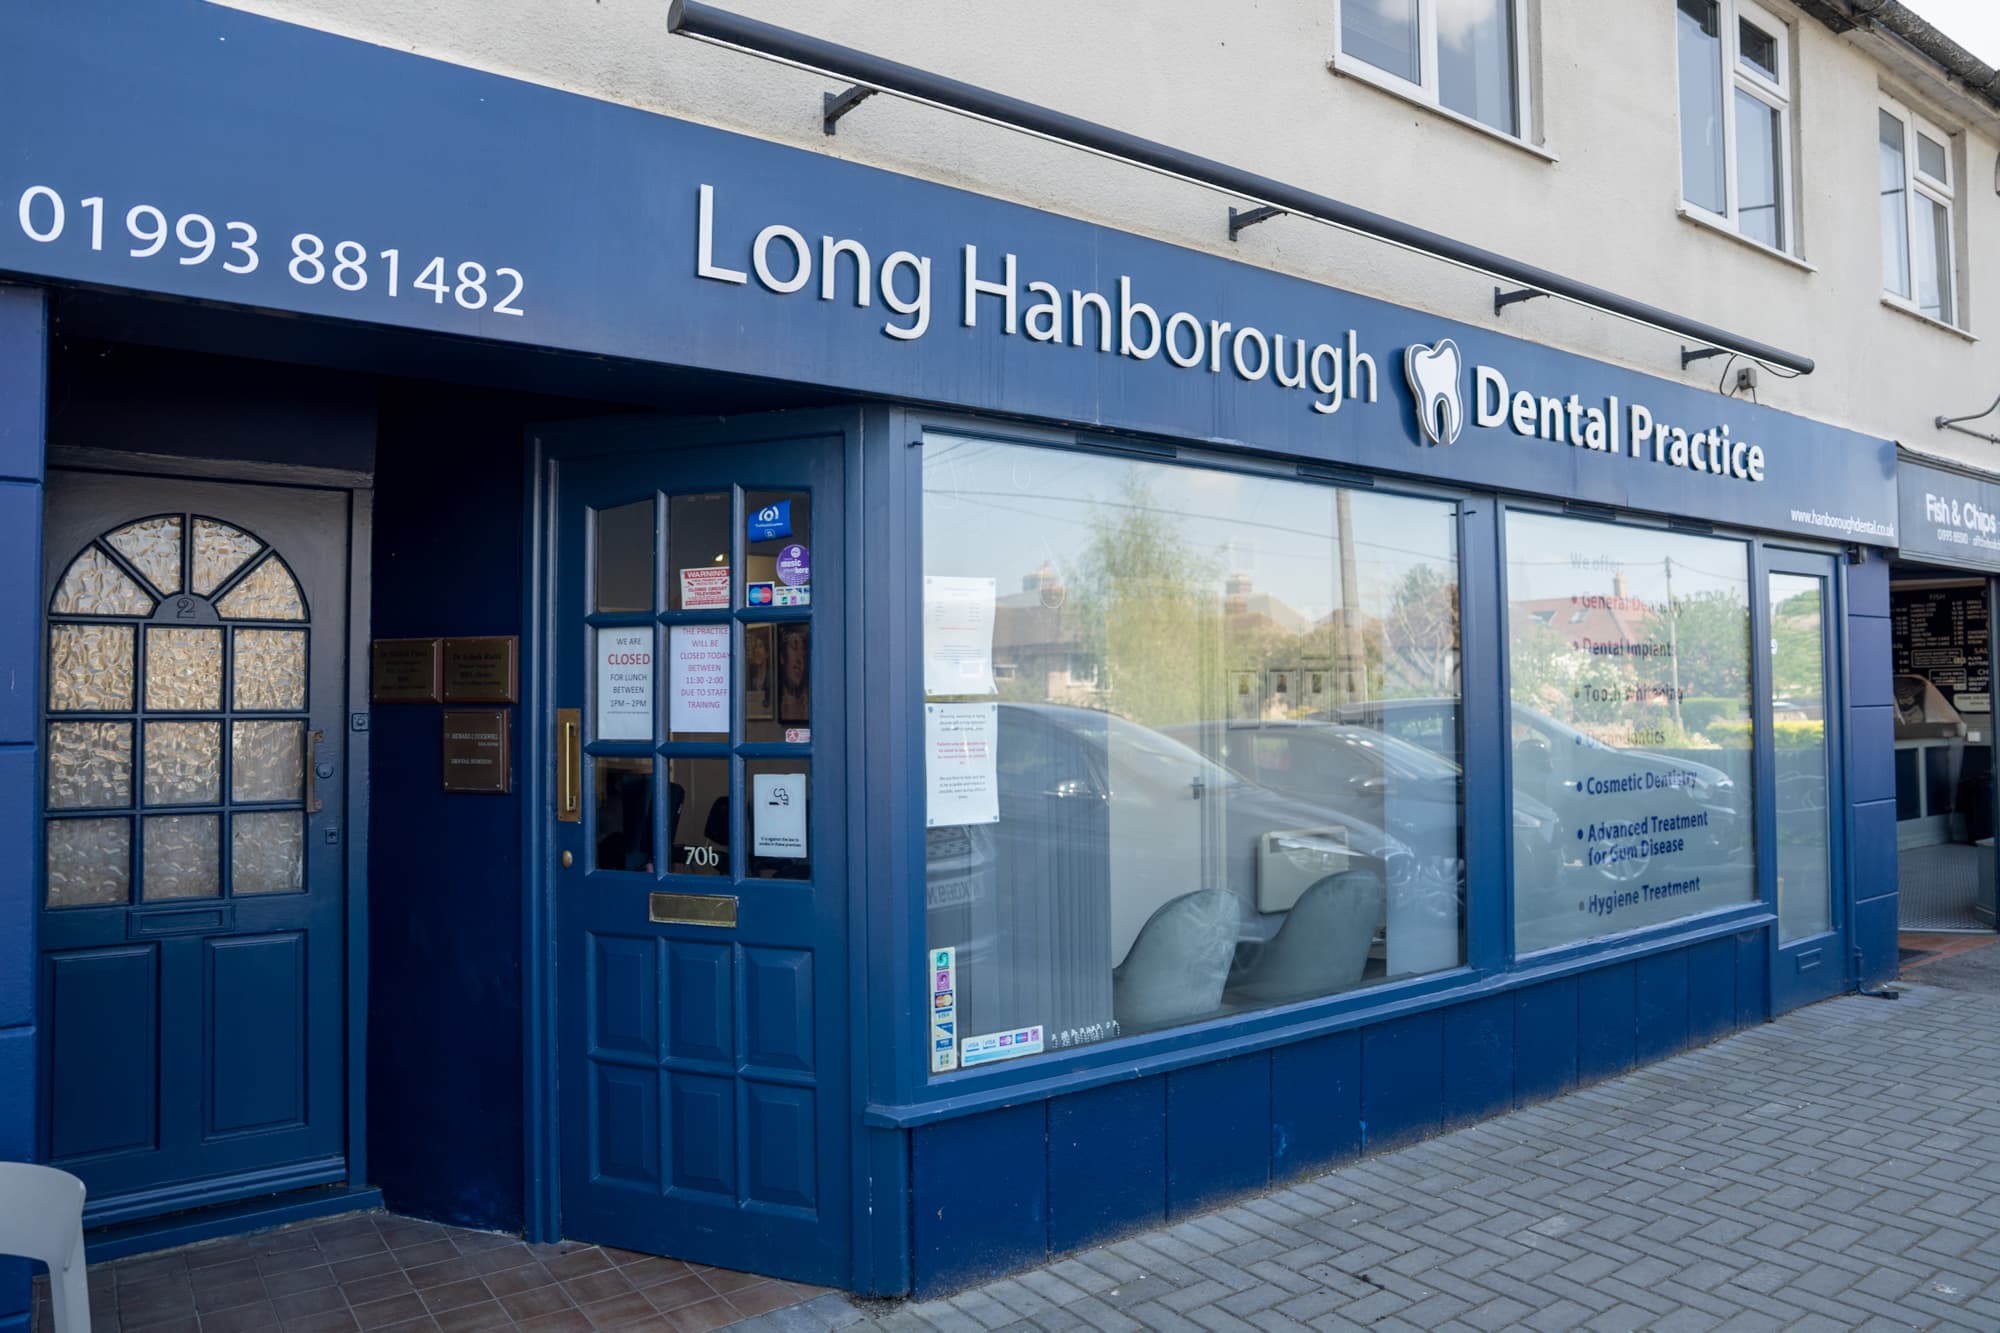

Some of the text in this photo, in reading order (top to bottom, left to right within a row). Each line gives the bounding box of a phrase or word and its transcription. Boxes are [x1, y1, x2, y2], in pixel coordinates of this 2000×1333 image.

[18, 185, 525, 316] 01993 881482
[697, 183, 1378, 415] Long Hanborough
[1475, 365, 1765, 482] Dental Practice
[1790, 508, 1895, 537] www.hanboroughdental.co.uk
[1926, 493, 1997, 536] Fish & Chips
[687, 569, 727, 578] WARNING
[176, 597, 197, 618] 2
[682, 627, 729, 635] THE PRACTICE
[680, 652, 730, 660] CLOSED TODAY
[1583, 637, 1624, 656] Dental
[608, 653, 651, 665] CLOSED
[688, 664, 721, 672] BETWEEN
[613, 686, 644, 694] BETWEEN
[680, 688, 728, 697] DUE TO STAFF
[688, 701, 721, 709] TRAINING
[1587, 769, 1697, 795] Cosmetic Dentistry
[1588, 811, 1708, 842] Advanced Treatment
[683, 846, 719, 866] 70b
[1588, 838, 1684, 866] for Gum Disease
[1588, 876, 1700, 916] Hygiene Treatment
